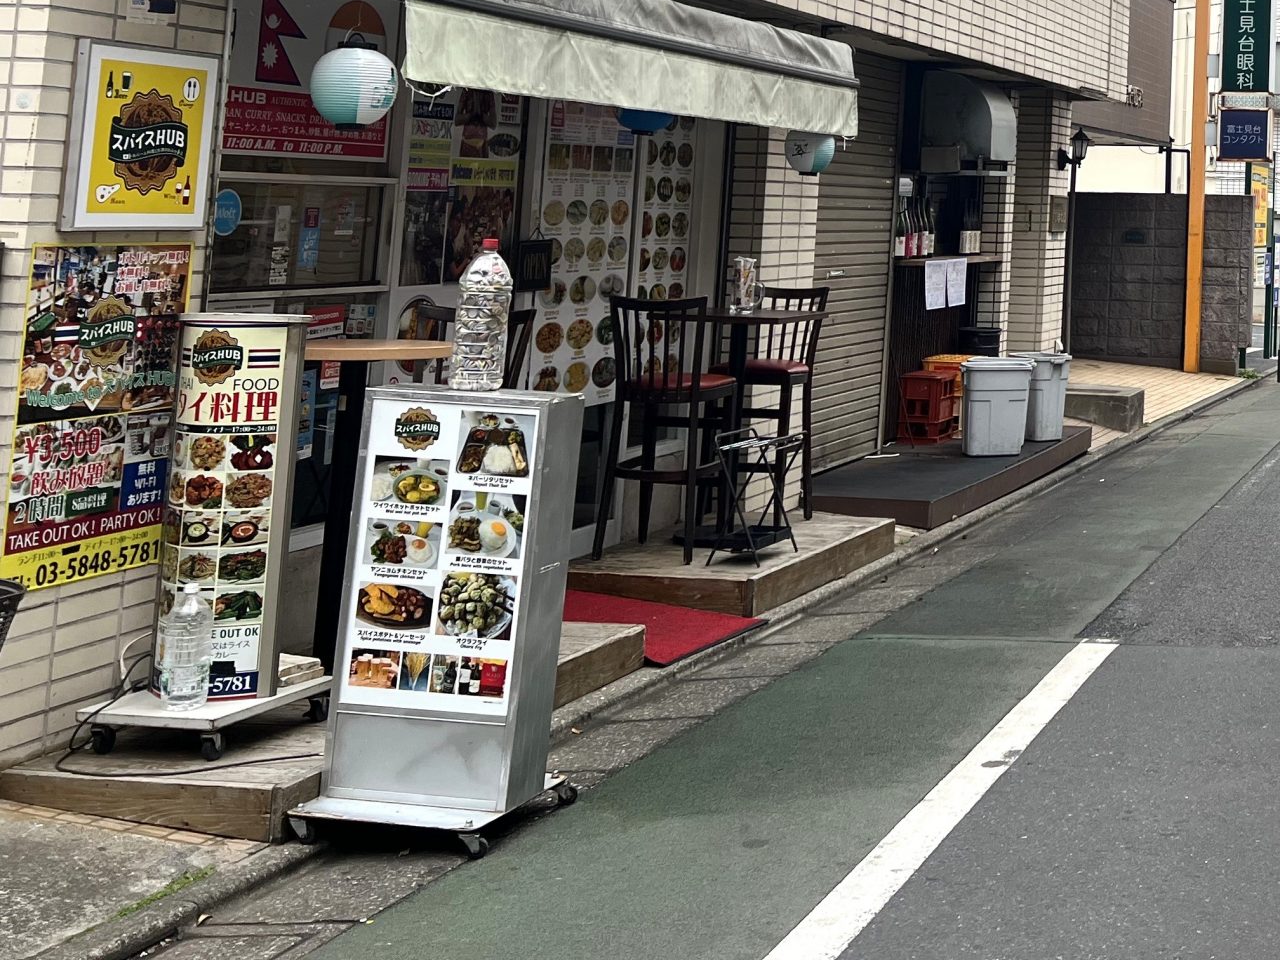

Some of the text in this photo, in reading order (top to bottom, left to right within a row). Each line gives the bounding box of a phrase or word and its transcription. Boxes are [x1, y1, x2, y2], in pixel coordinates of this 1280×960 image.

[231, 90, 267, 105] HUB
[1226, 124, 1262, 134] 富士見台
[112, 129, 185, 151] スパイスHUB
[226, 137, 344, 154] 11:00 A.M. to 11:00 P.M.
[1223, 134, 1264, 144] コンタクト
[80, 319, 135, 343] スパイスHUB
[193, 349, 241, 363] スパイスHUB
[233, 378, 280, 391] FOOD
[177, 390, 278, 423] タイ料理
[396, 424, 439, 434] スパイスHUB
[137, 462, 156, 476] 無料
[14, 494, 65, 525] 2時間
[8, 530, 40, 551] TAKE
[42, 525, 69, 544] OUT
[71, 520, 95, 539] OK!
[100, 512, 137, 532] PARTY
[35, 539, 160, 587] 03-5848-5781
[219, 627, 259, 639] OUT OK
